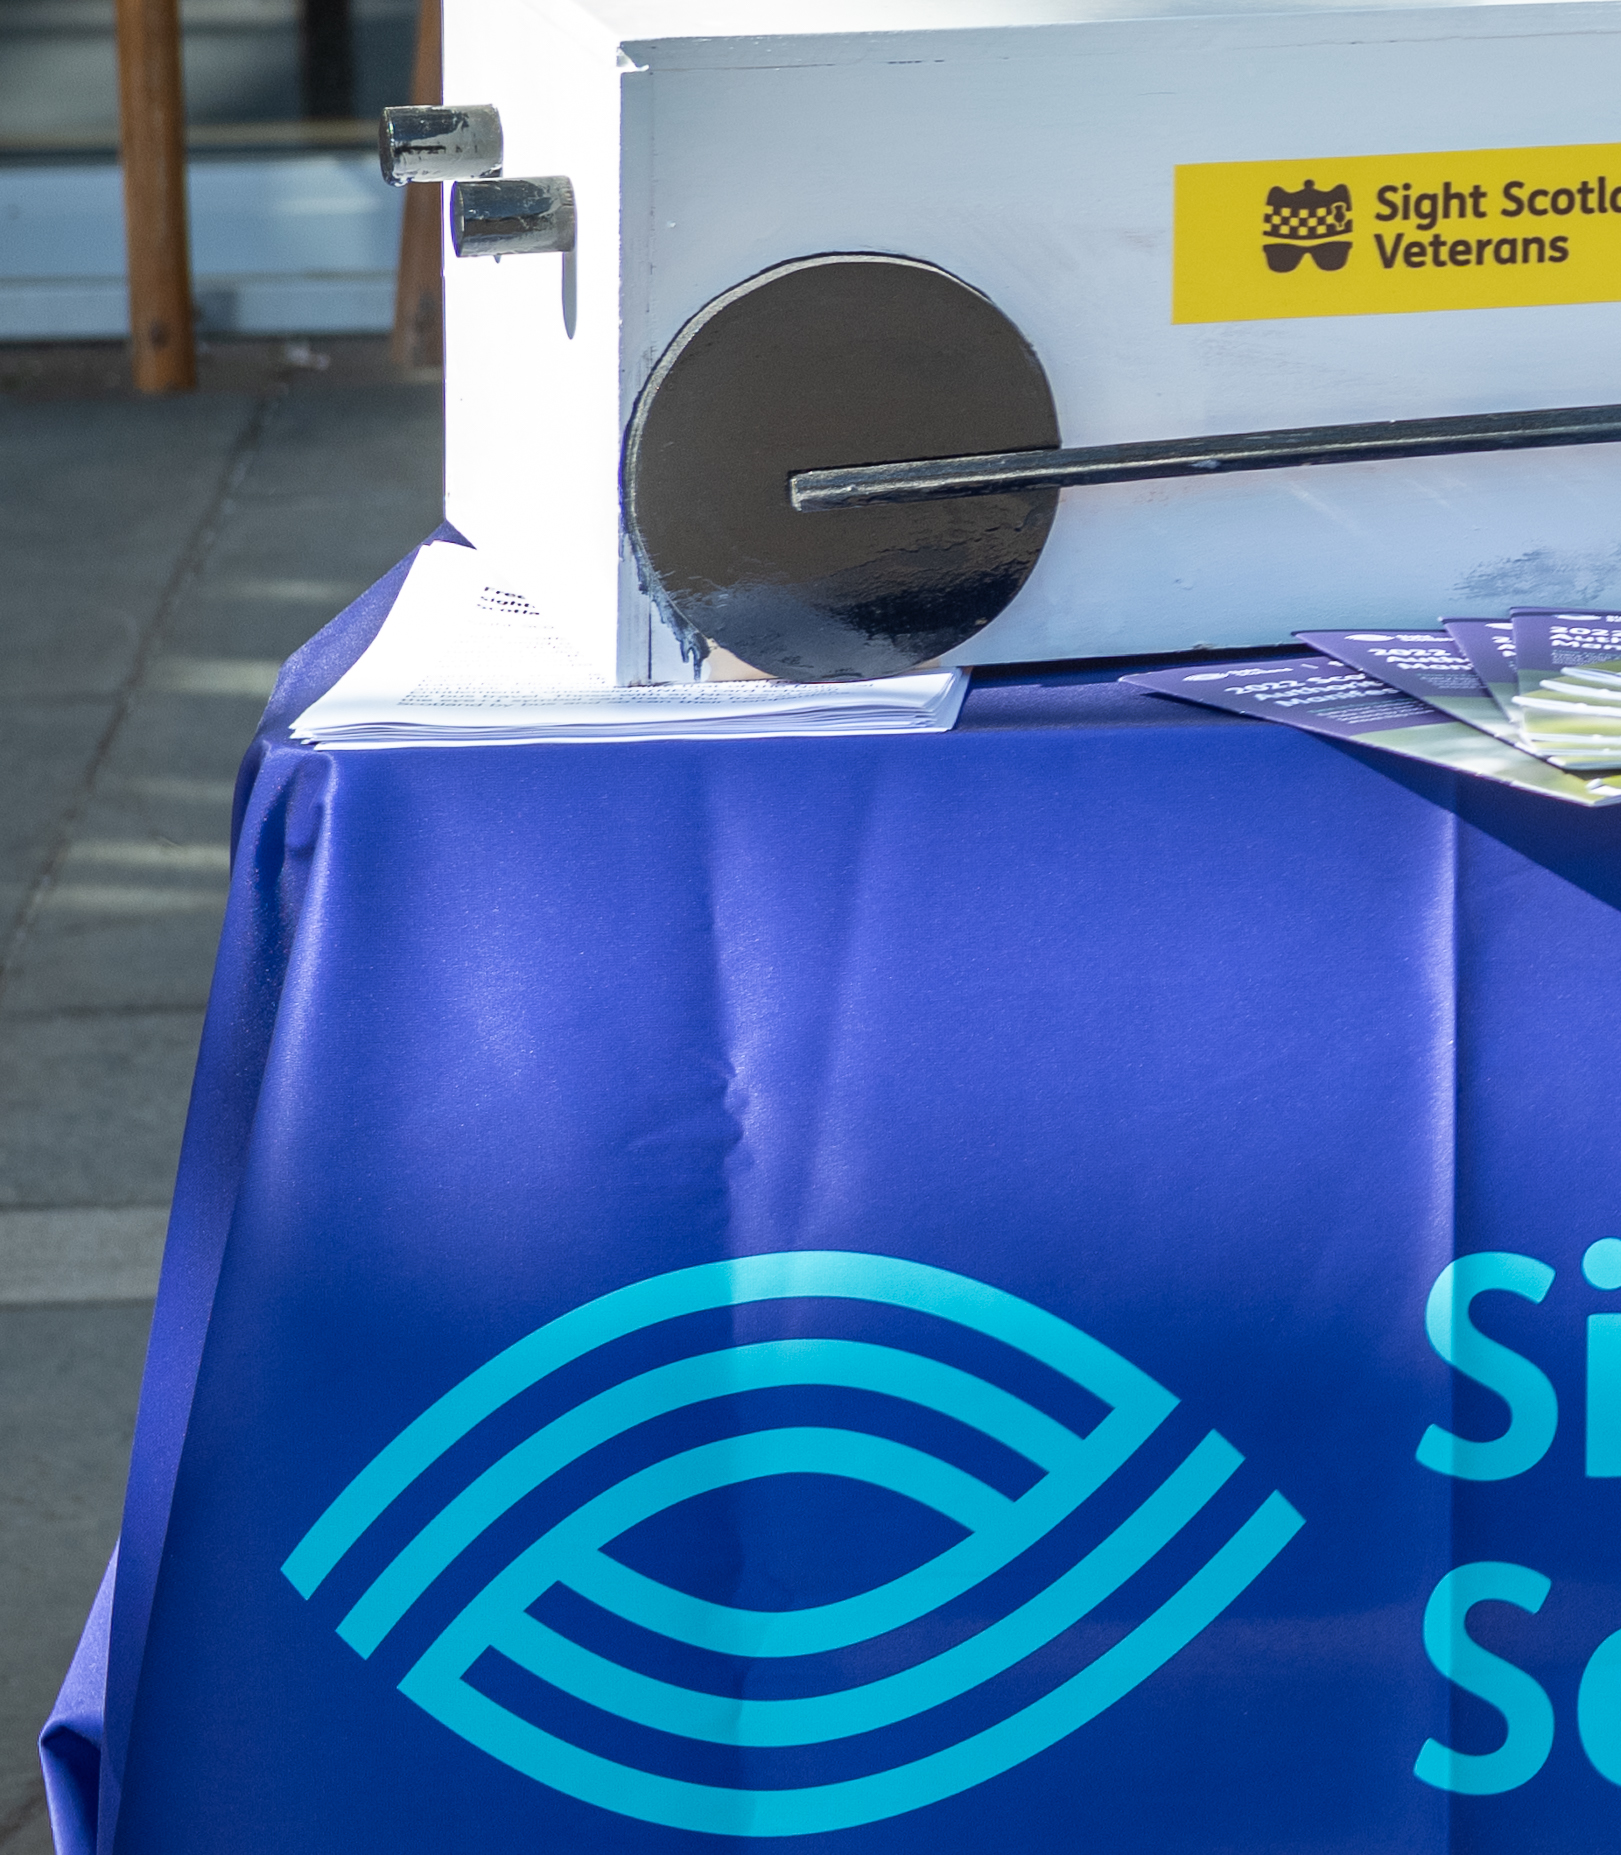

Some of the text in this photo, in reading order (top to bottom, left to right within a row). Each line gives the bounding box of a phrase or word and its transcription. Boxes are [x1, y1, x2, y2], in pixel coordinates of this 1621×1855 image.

[1374, 181, 1488, 232] Sight
[1373, 228, 1569, 269] Veterans
[1224, 680, 1305, 695] 2022
